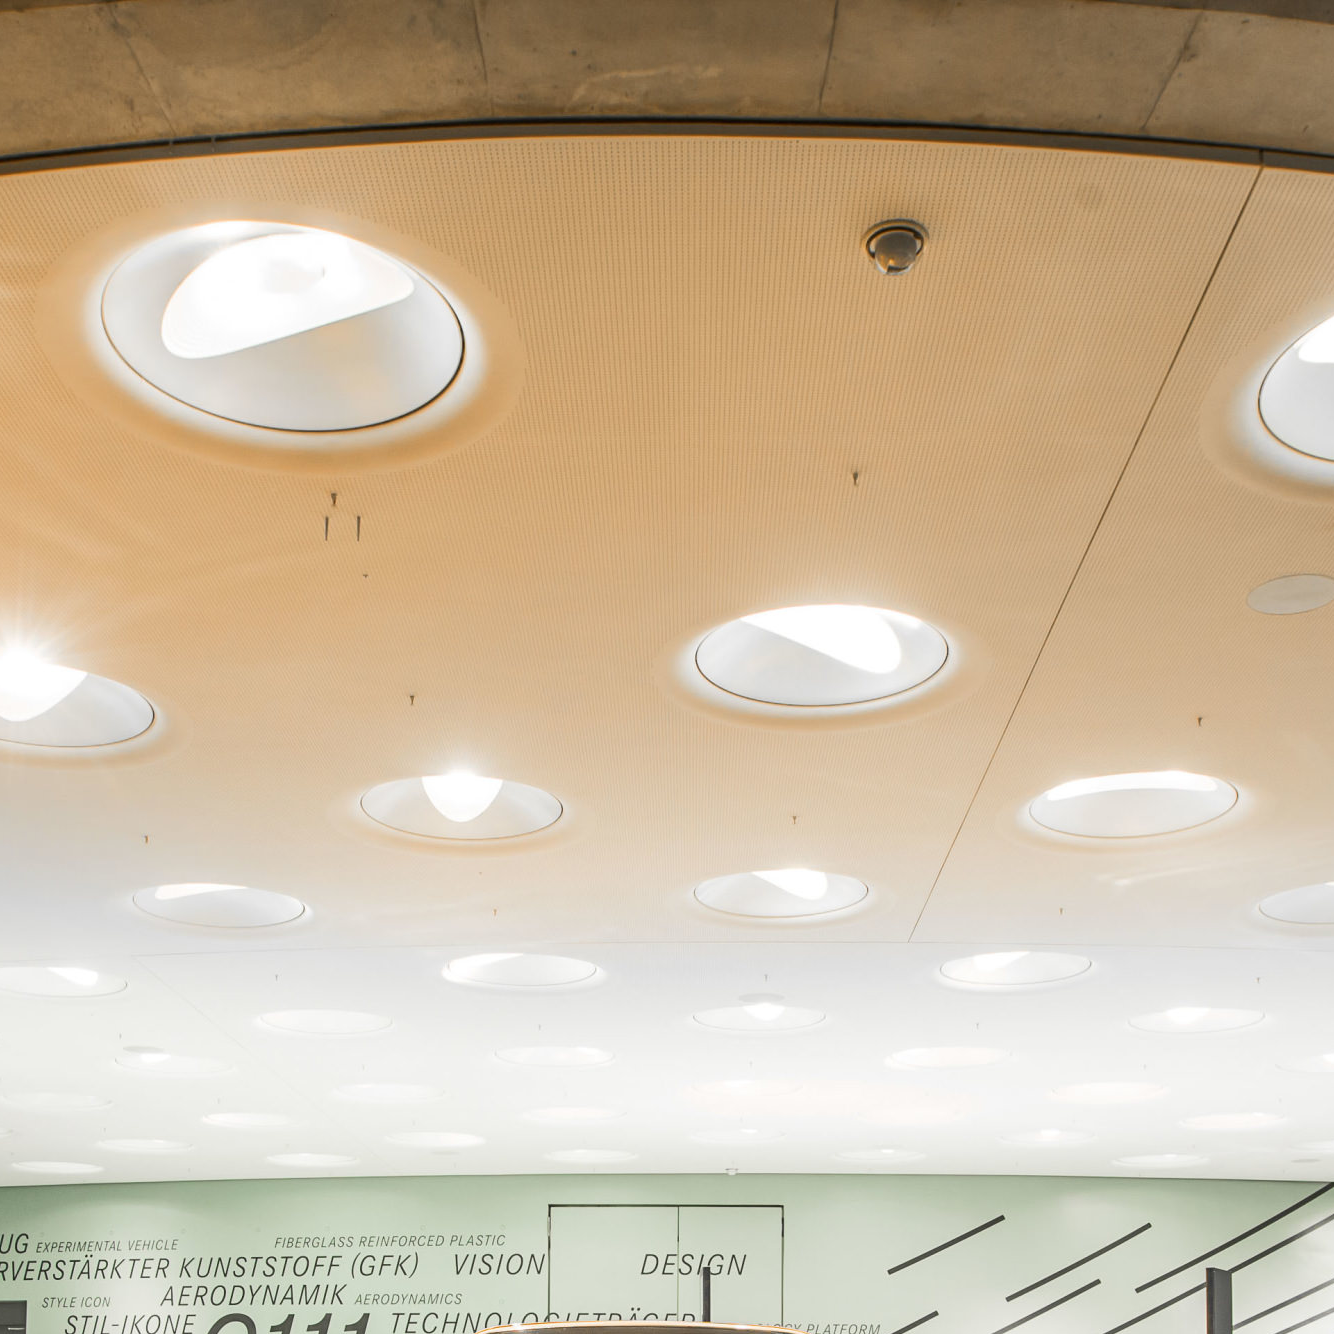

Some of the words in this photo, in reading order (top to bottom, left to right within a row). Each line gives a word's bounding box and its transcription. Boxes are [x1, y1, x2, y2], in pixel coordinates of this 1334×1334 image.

[36, 1240, 122, 1253] EXPERIMENTAL
[127, 1238, 179, 1251] VEHICLE
[274, 1236, 354, 1249] FIBERGLASS
[358, 1235, 444, 1248] REINFORCED
[449, 1234, 506, 1247] PLASTIC
[179, 1255, 343, 1279] KUNSTSTOFF
[351, 1252, 419, 1279] (GFK)
[454, 1253, 546, 1276] VISION
[640, 1253, 747, 1276] DESIGN
[42, 1297, 76, 1309] STYLE
[80, 1296, 111, 1309] ICON
[160, 1284, 347, 1307] AERODYNAMIK
[354, 1293, 463, 1306] AERODYNAMICS
